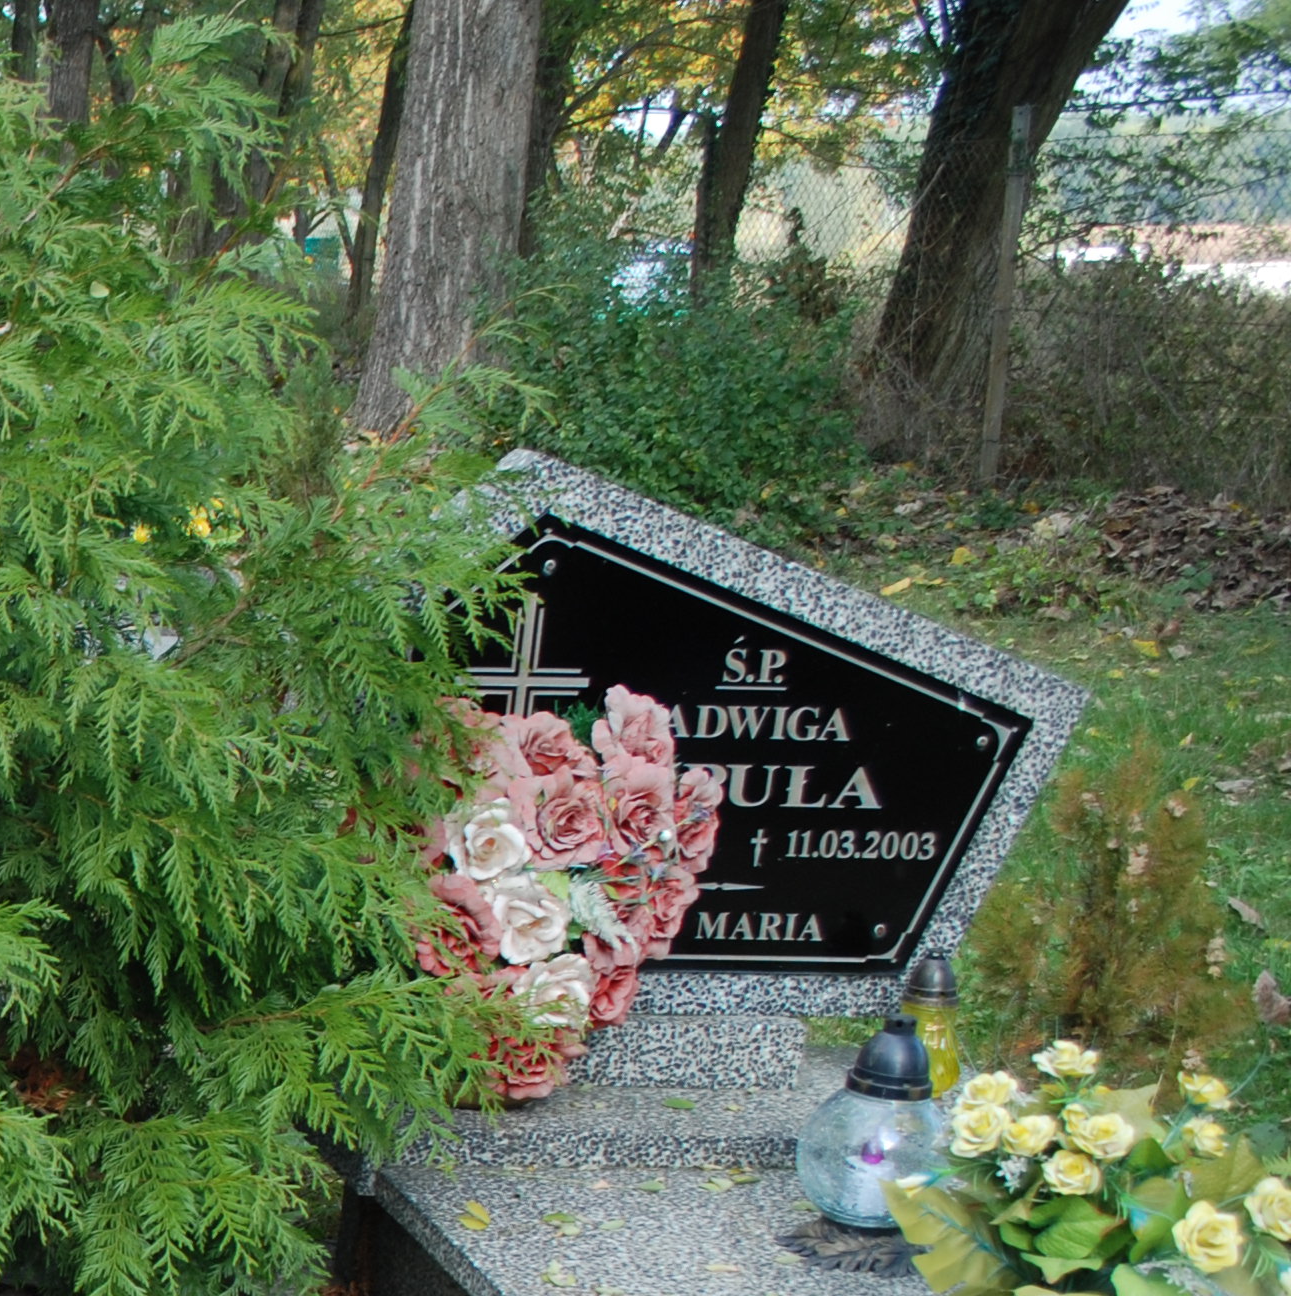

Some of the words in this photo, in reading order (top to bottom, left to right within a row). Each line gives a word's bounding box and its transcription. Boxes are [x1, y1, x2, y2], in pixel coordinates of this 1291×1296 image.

[722, 636, 787, 684] Ś.P.
[668, 704, 851, 742] ADWIGA
[785, 829, 937, 861] 11.03.2003
[694, 911, 823, 942] MARIA
